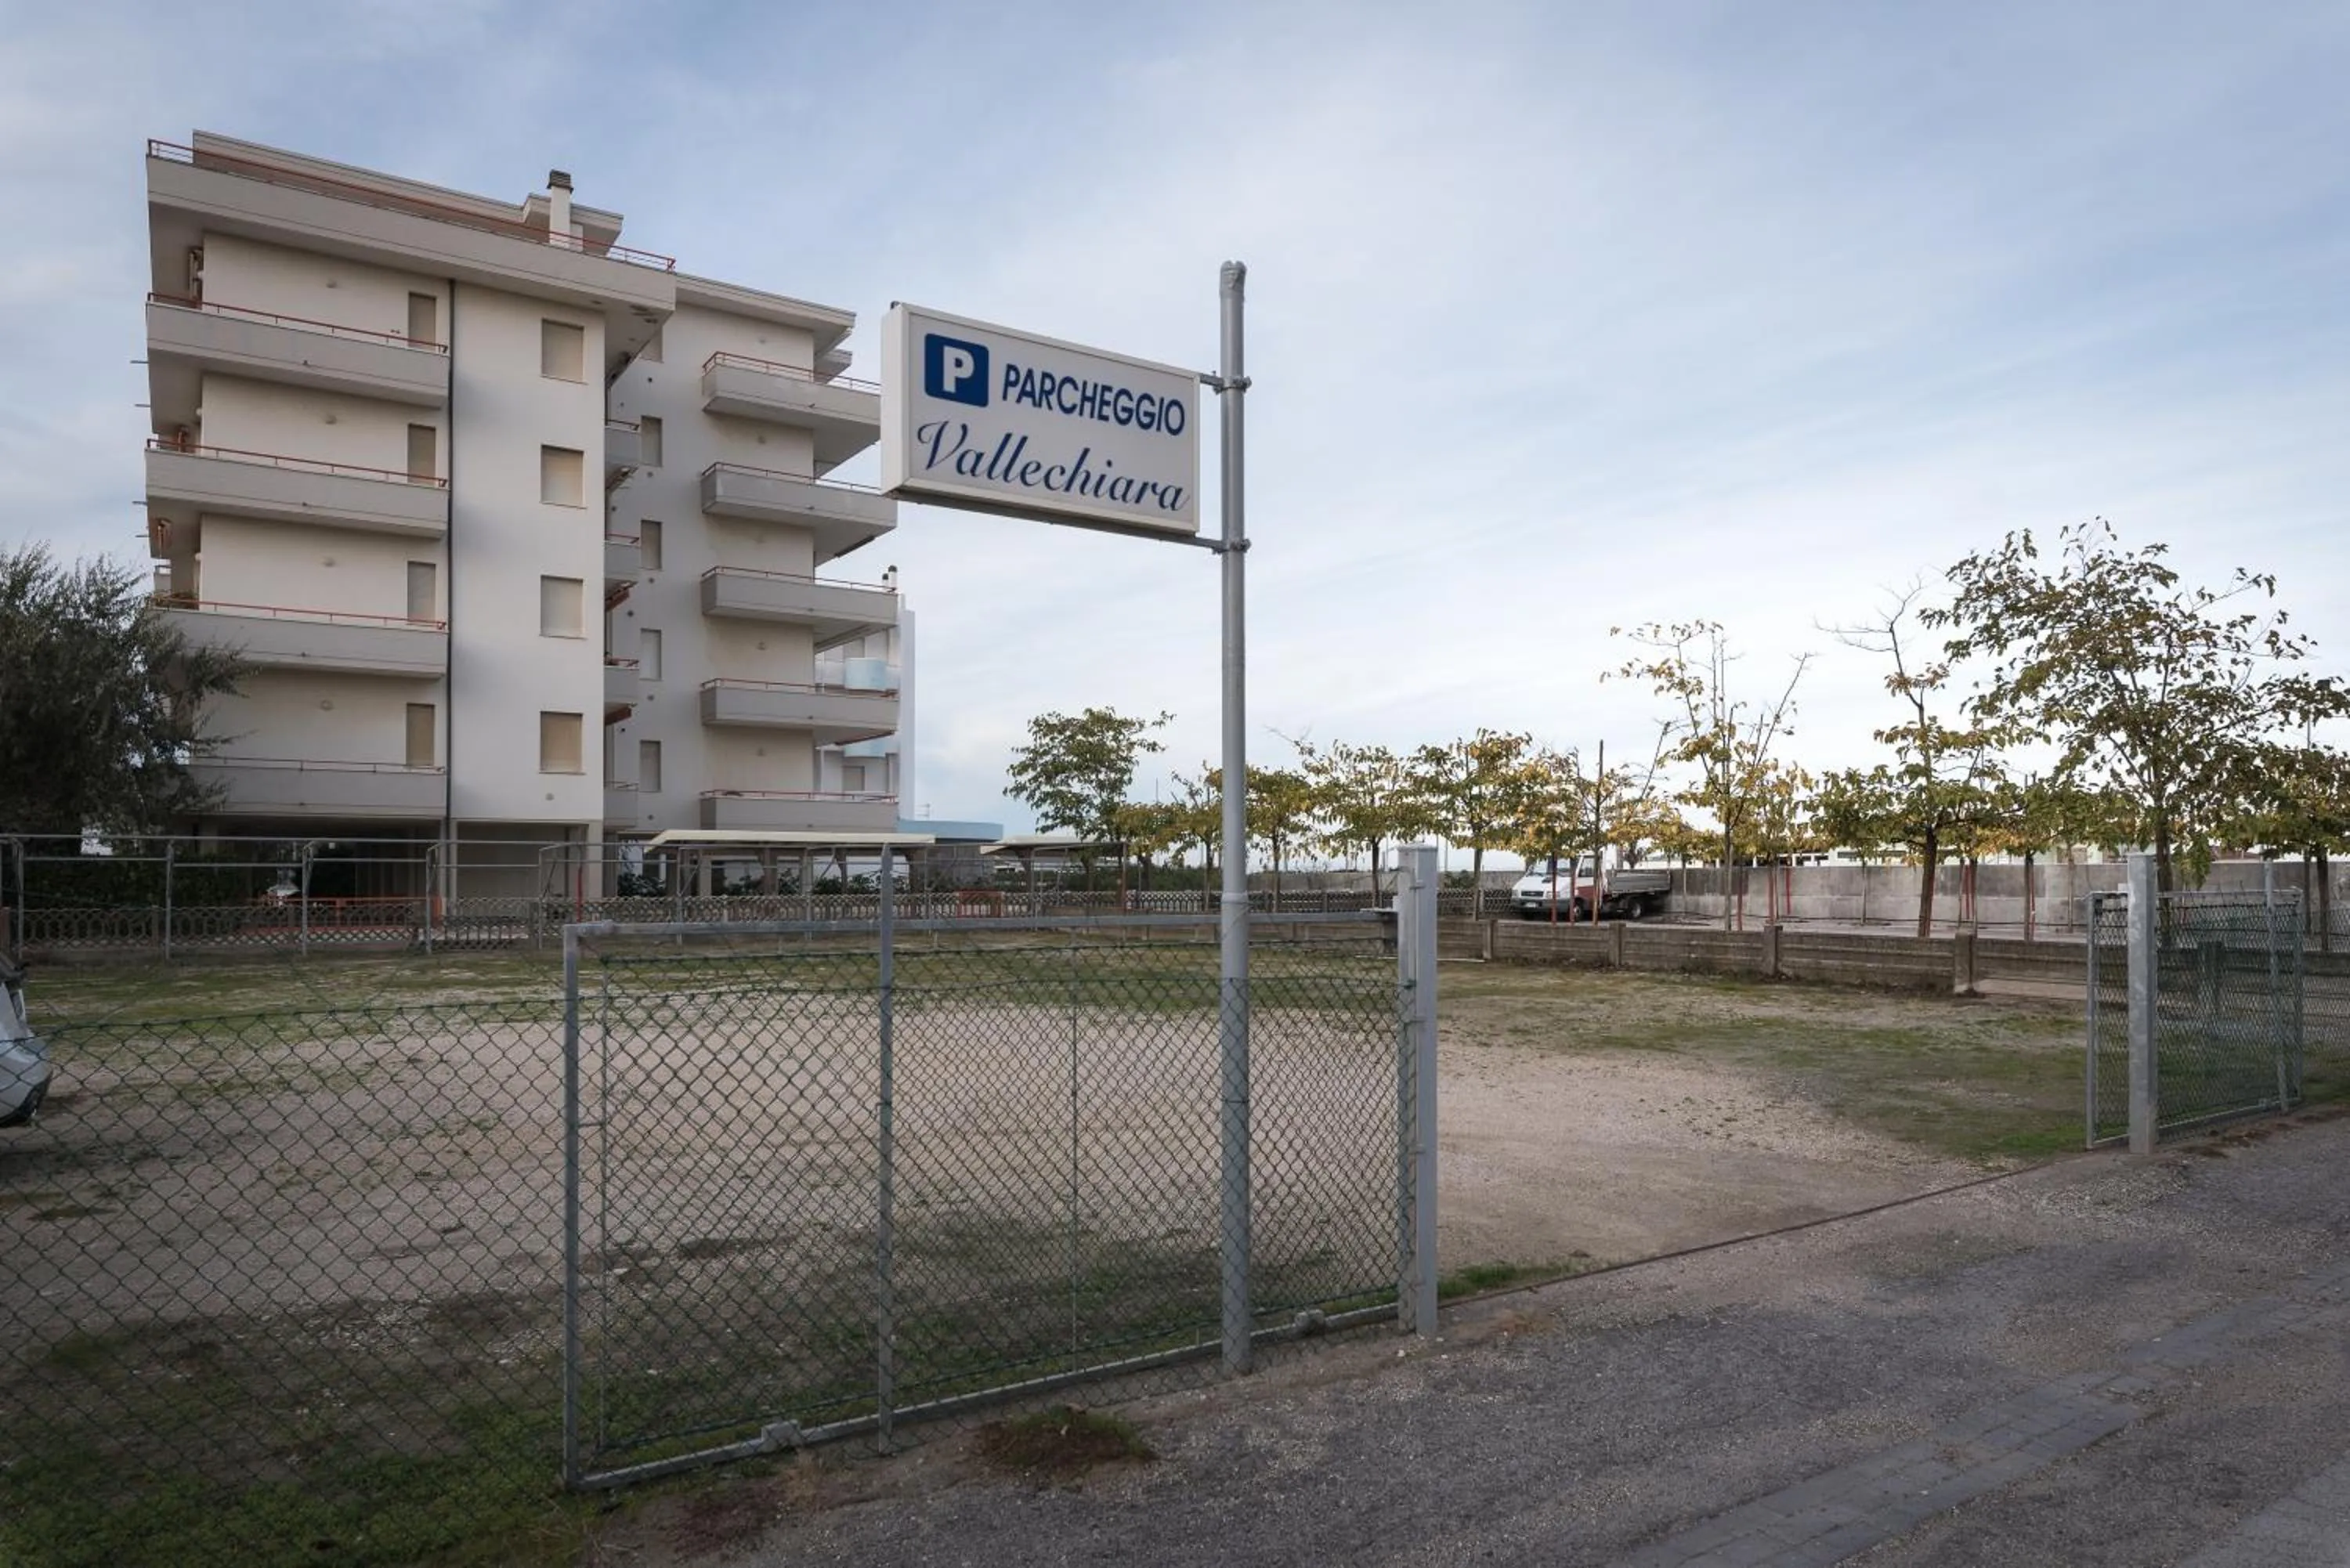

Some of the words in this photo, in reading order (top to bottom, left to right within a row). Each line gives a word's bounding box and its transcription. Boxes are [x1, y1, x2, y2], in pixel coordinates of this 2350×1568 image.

[942, 345, 974, 393] P
[1002, 363, 1185, 435] PARCHEGGIO
[917, 420, 1190, 511] Vallechiara
